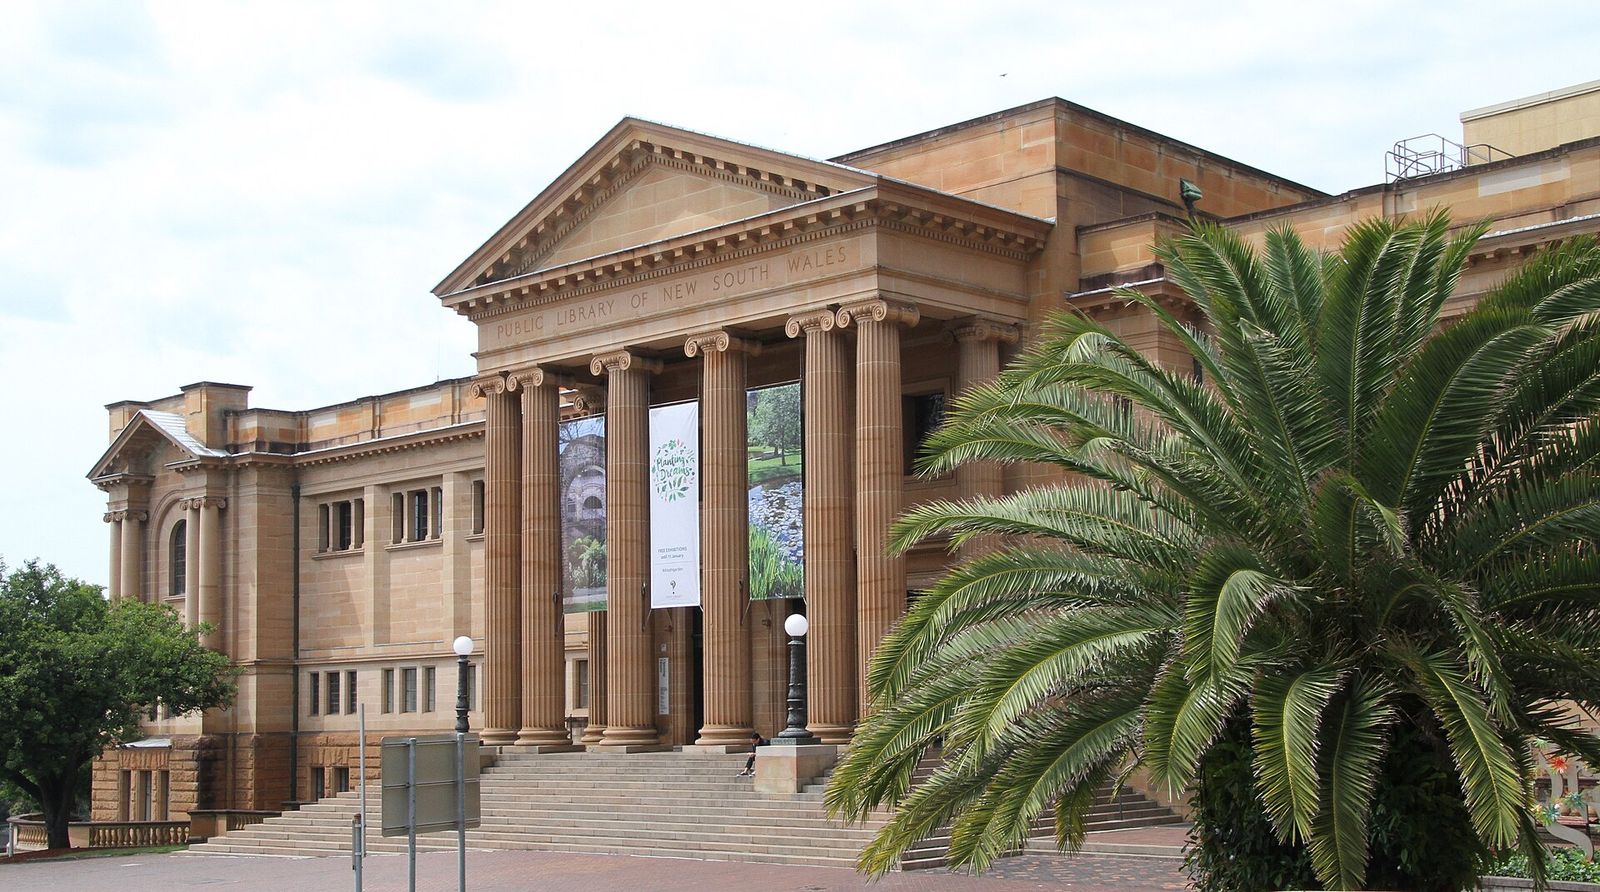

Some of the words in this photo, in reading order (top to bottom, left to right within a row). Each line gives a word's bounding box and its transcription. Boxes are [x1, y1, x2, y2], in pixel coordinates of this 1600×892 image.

[498, 316, 544, 339] PUBLIC
[557, 300, 615, 326] LIBRARY
[631, 292, 648, 309] OF
[663, 281, 697, 302] NEW
[713, 263, 769, 291] SOUTH
[788, 246, 846, 273] WALES
[657, 454, 686, 471] Planting
[660, 467, 690, 481] Dreams
